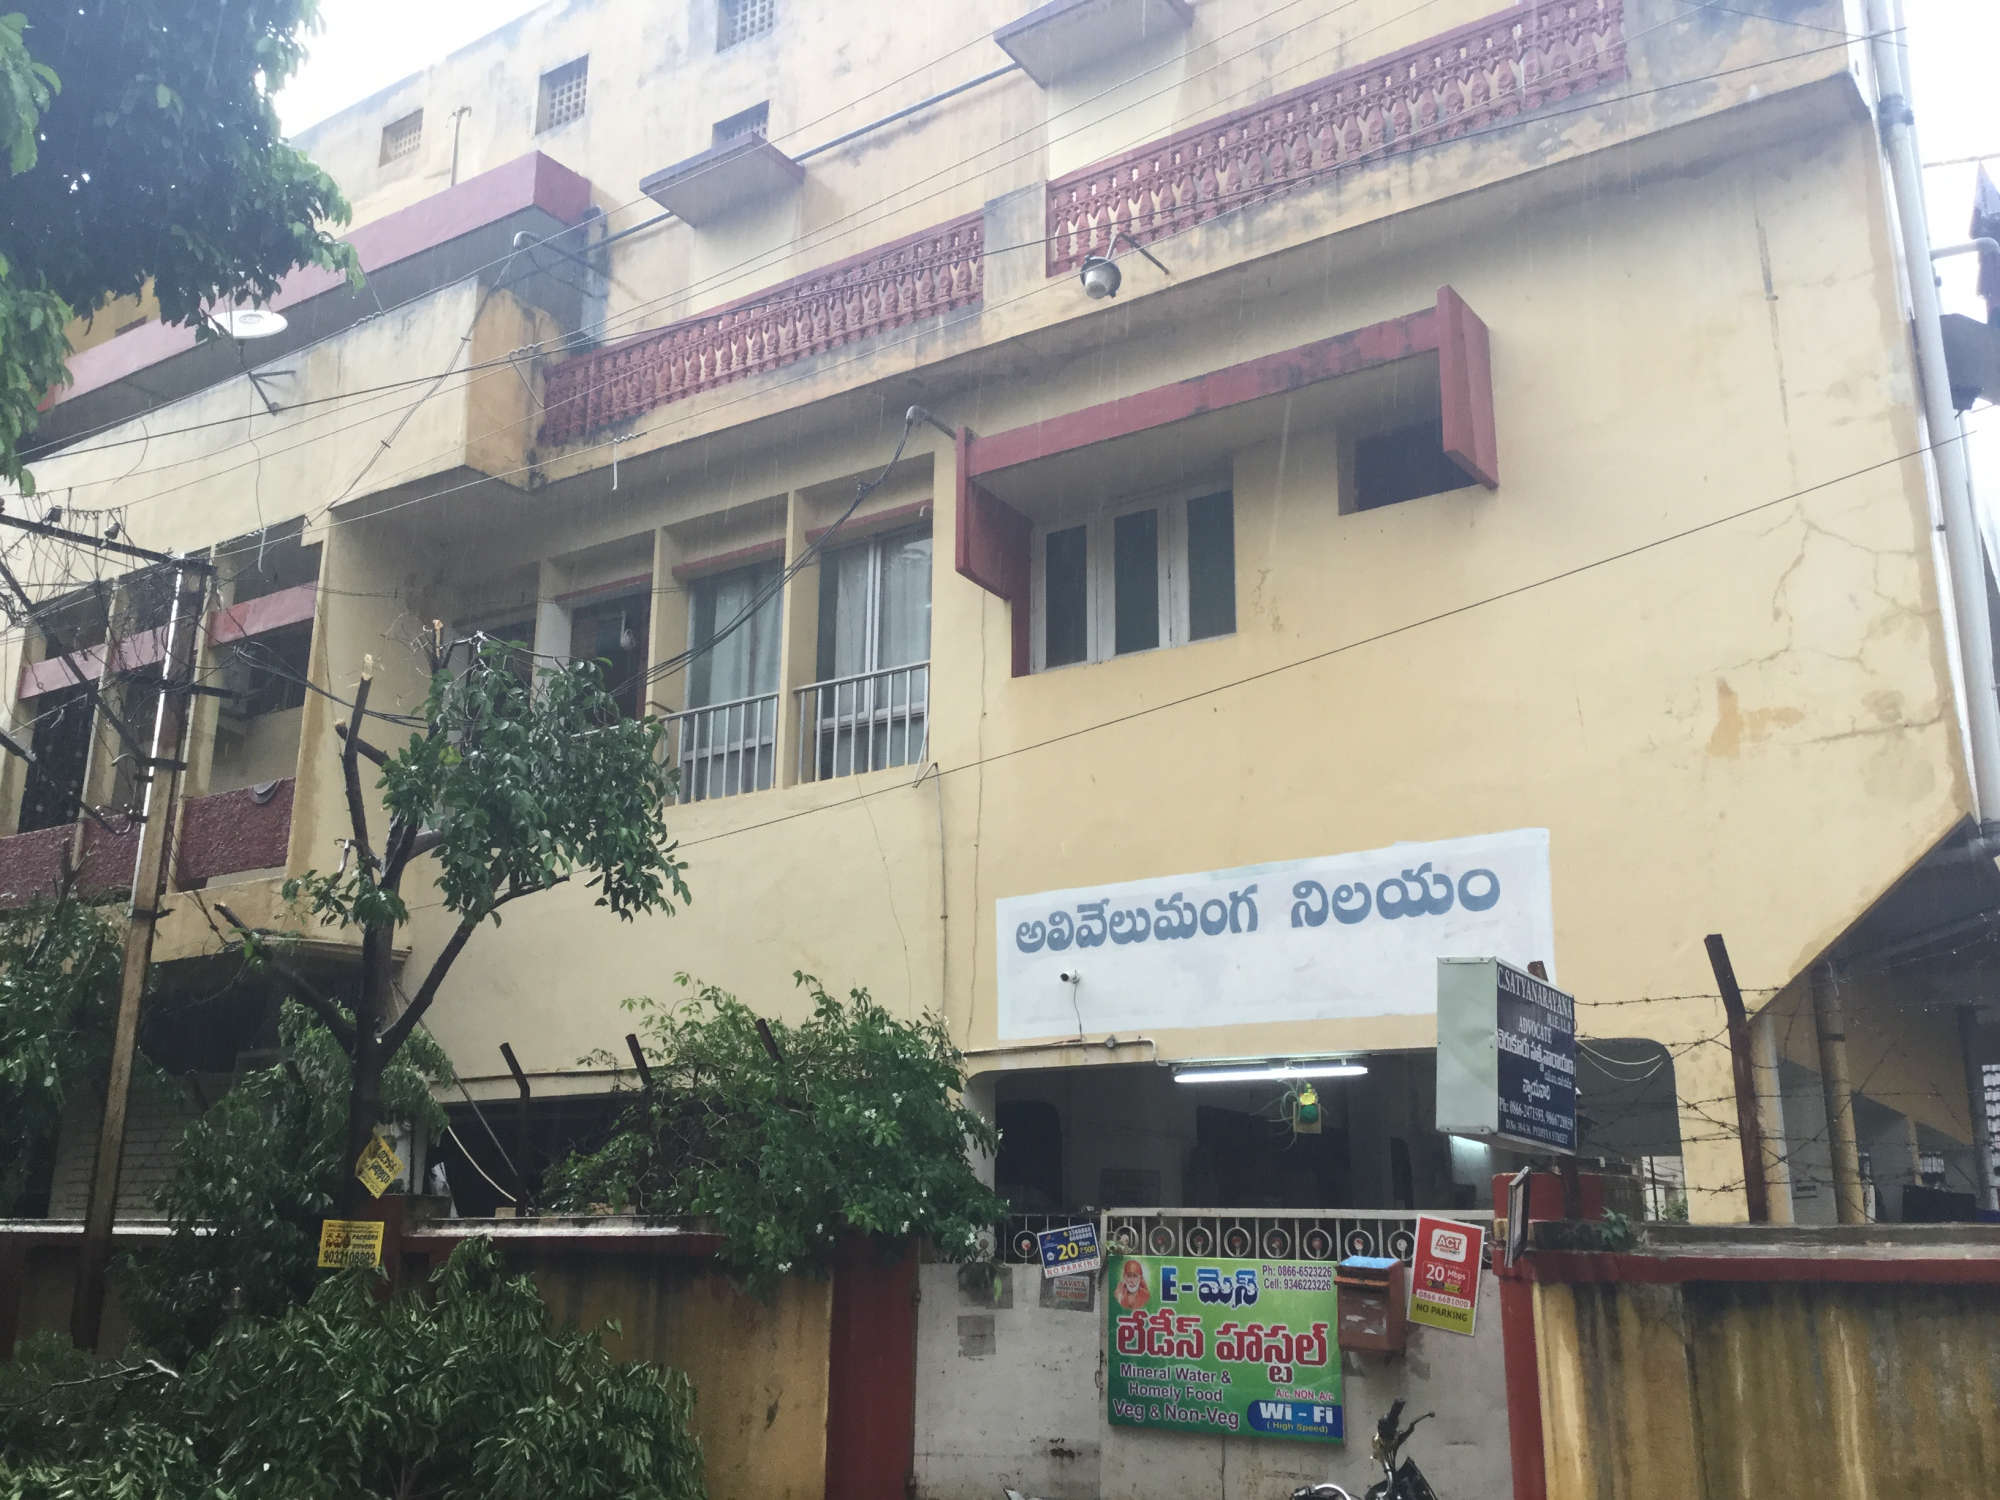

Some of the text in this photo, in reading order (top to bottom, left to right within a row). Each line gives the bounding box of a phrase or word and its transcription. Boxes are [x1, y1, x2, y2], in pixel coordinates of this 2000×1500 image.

[1291, 862, 1502, 929] నిలయం
[1519, 1015, 1553, 1044] ADVOCATE
[1056, 1242, 1079, 1260] 20
[1436, 1234, 1462, 1250] ACT
[1047, 1260, 1099, 1277] NO PARKING
[1262, 1264, 1332, 1278] Ph: 0866-6523226
[1426, 1263, 1445, 1281] 20
[1263, 1278, 1331, 1290] Cell: 9346223226
[1416, 1303, 1468, 1322] NO PARKING
[1215, 1323, 1329, 1384] హాస్టల్
[1120, 1364, 1232, 1384] Mineral Water &
[1128, 1383, 1223, 1402] Homely Food
[1113, 1400, 1240, 1430] Veg & Non-Veg
